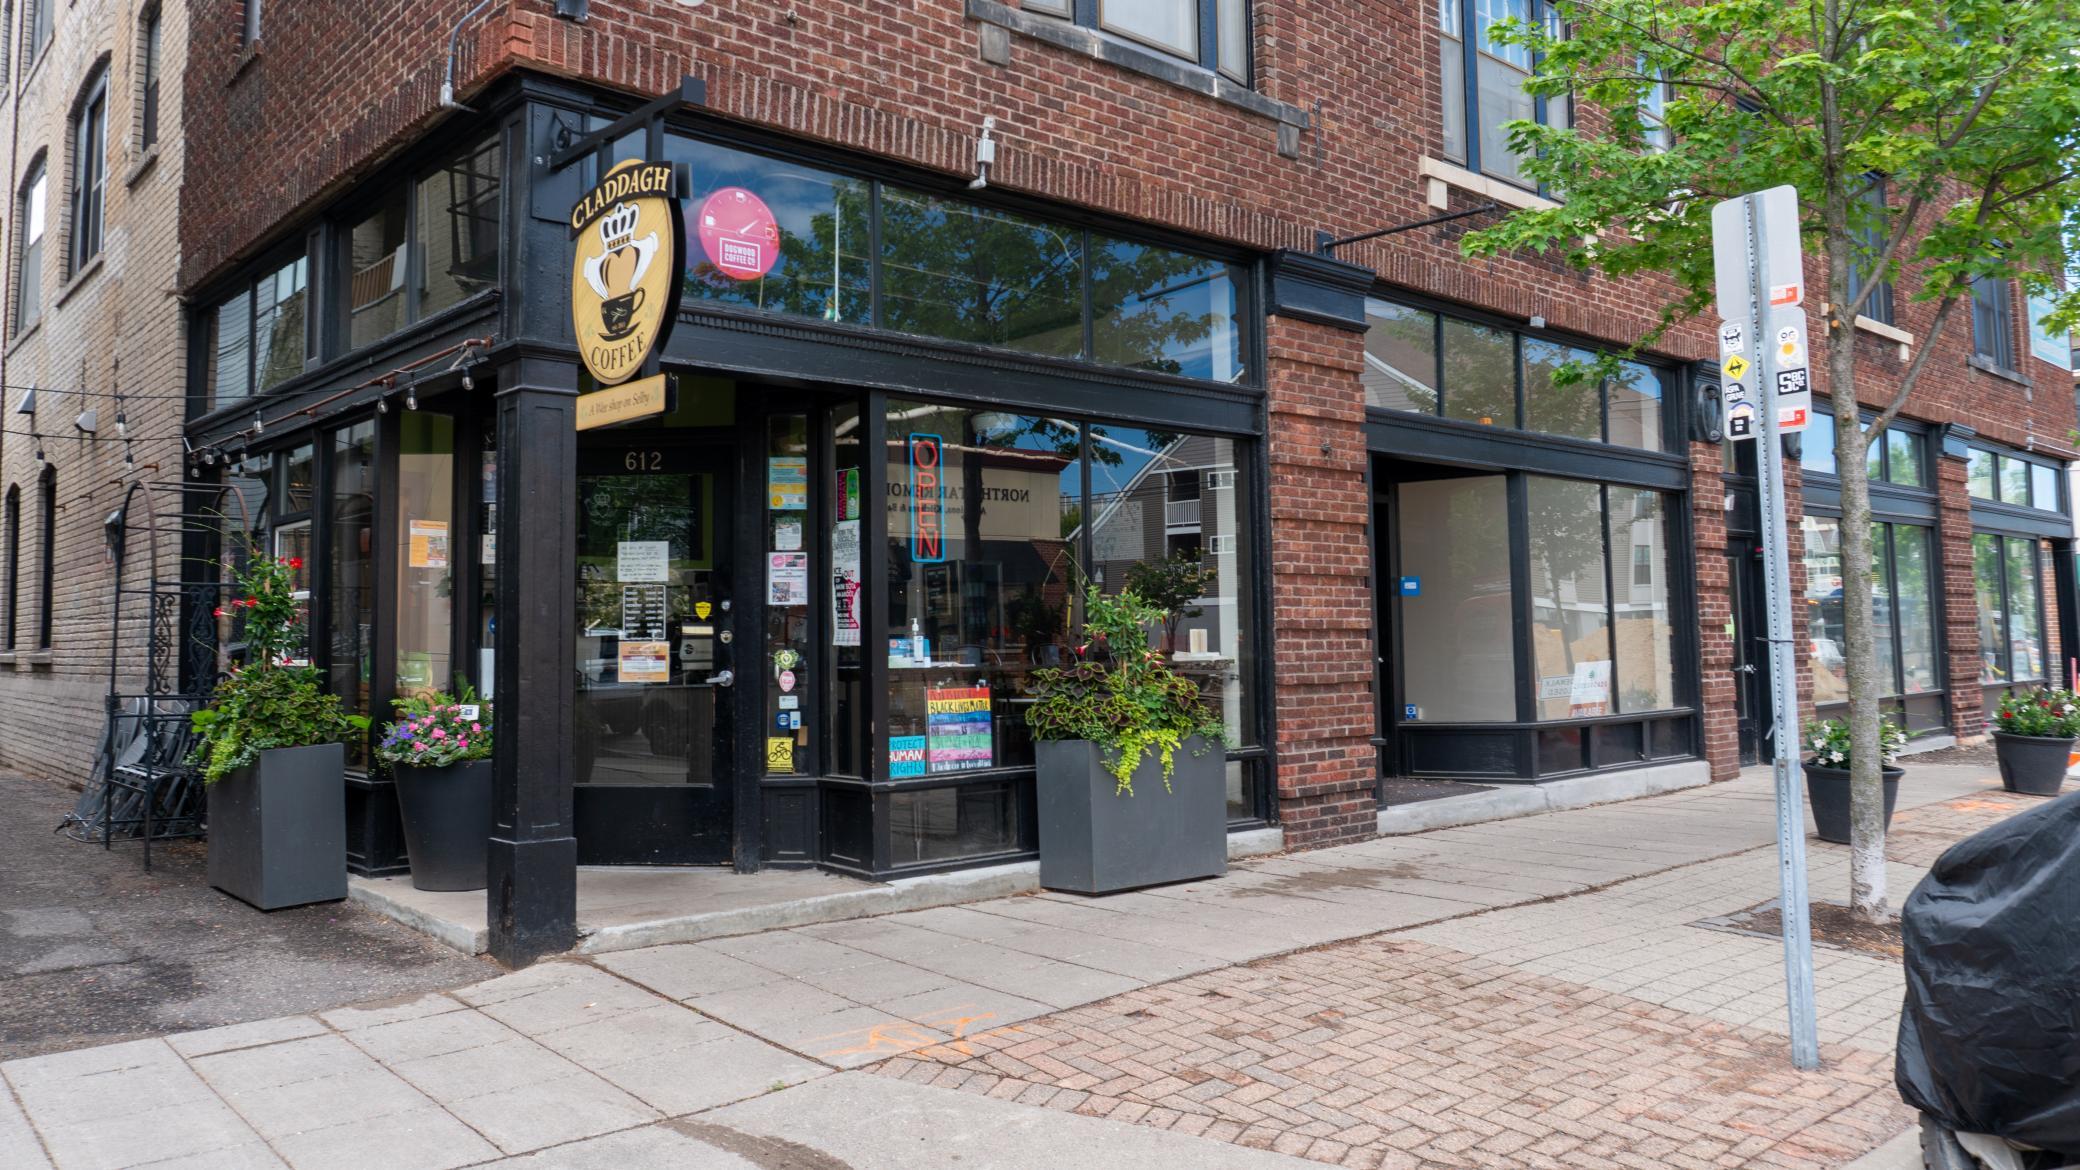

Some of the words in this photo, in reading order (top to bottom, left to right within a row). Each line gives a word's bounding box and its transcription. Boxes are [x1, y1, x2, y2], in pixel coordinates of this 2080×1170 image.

[572, 167, 671, 229] CLADDAGH
[591, 332, 647, 370] COFFEE
[625, 451, 662, 470] 612
[914, 440, 938, 557] OPEN
[930, 701, 952, 714] BLACK
[955, 701, 969, 712] LIVES
[889, 750, 923, 762] HUMAN
[890, 761, 922, 775] RIGHTS
